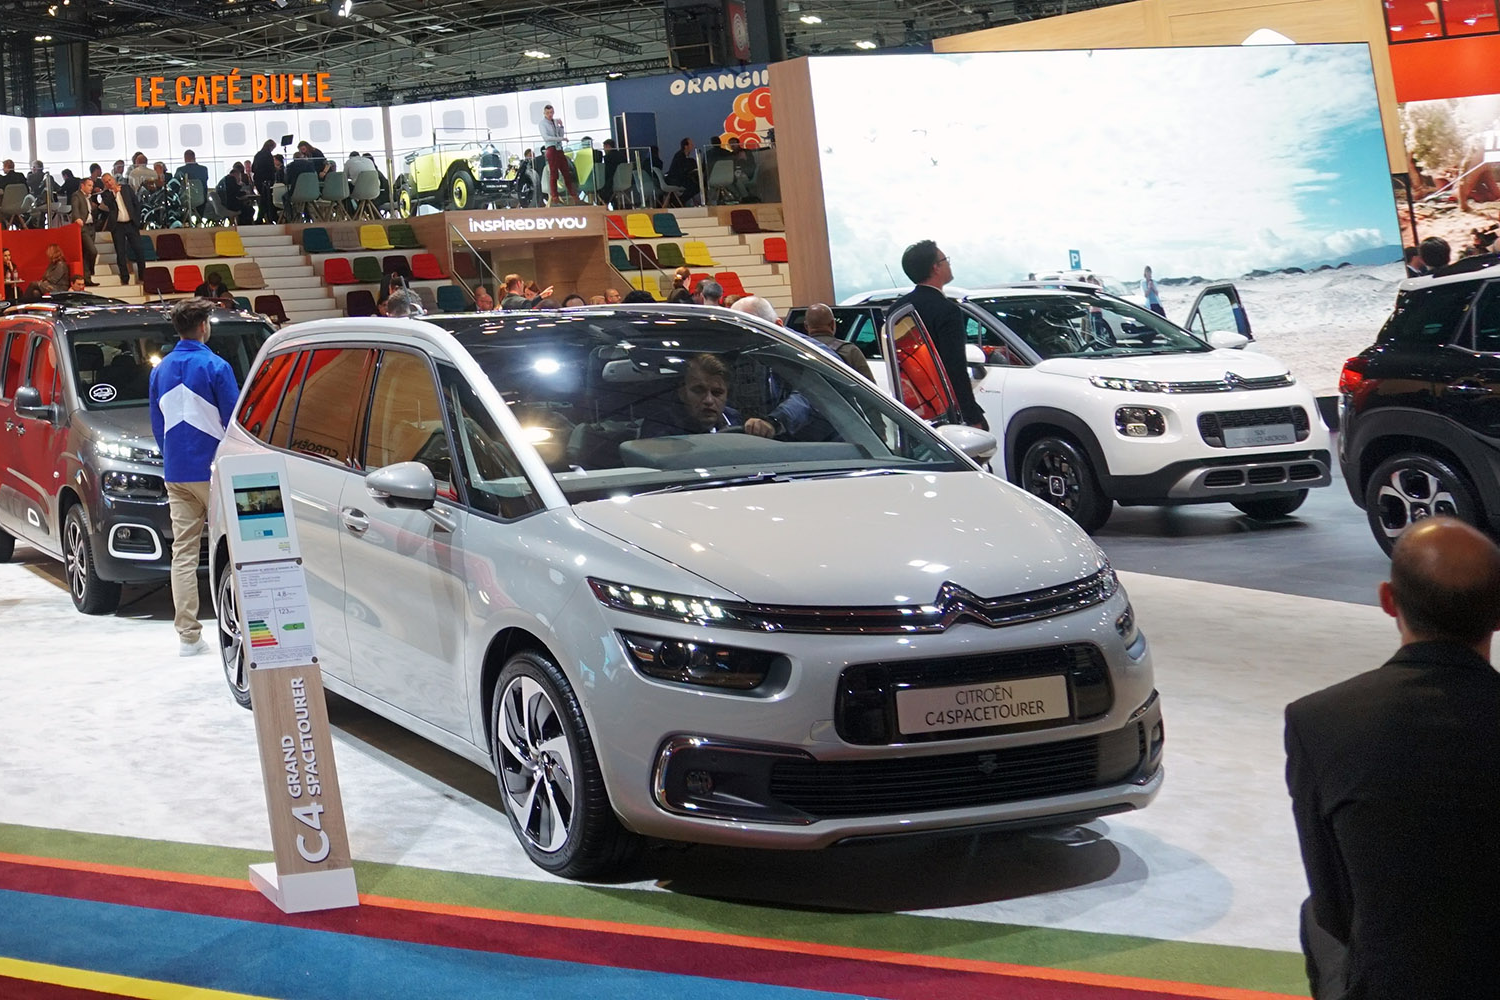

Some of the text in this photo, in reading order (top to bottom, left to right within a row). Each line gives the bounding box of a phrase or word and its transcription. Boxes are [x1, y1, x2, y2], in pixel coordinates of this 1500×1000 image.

[135, 67, 332, 107] LE CAFÉ BULLE
[536, 218, 556, 230] BY
[556, 217, 588, 230] YOU
[955, 685, 1013, 705] CITROËN
[291, 676, 321, 796] SPACETOURER
[281, 735, 302, 798] GRAND
[291, 802, 331, 863] C4
